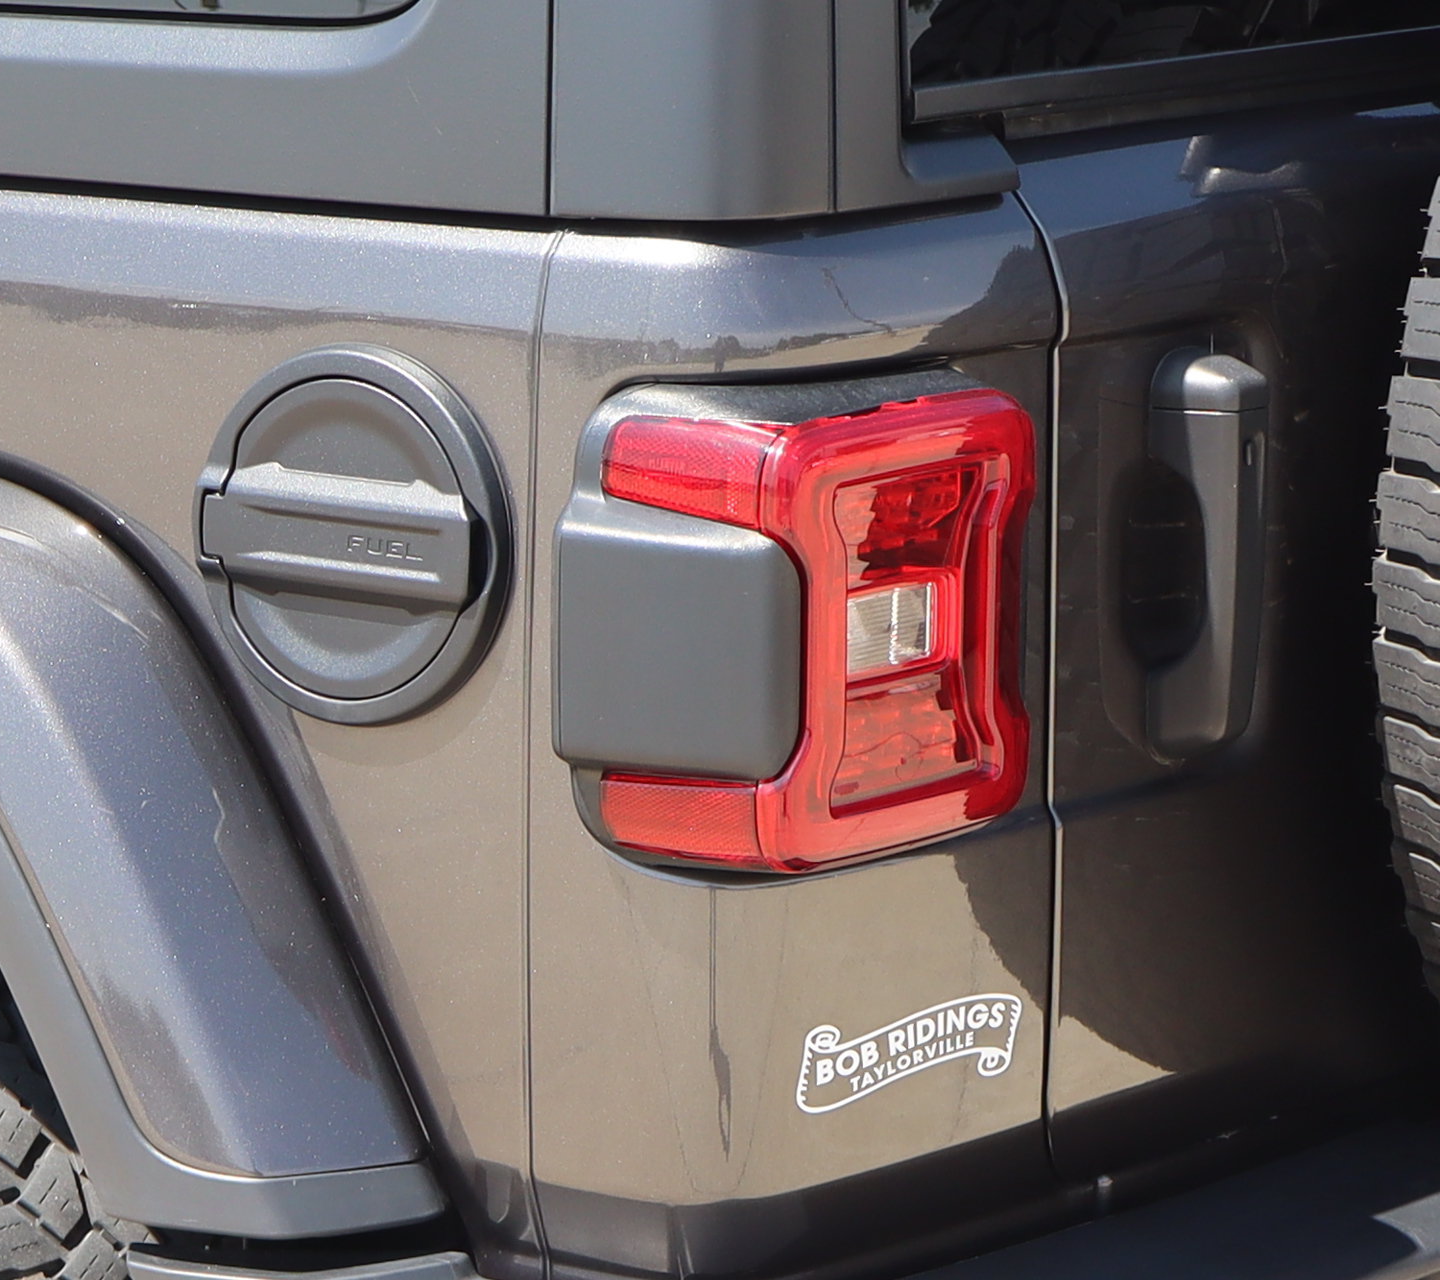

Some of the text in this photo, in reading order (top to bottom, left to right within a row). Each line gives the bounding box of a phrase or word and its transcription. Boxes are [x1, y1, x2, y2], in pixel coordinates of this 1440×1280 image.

[346, 535, 424, 562] FUEL
[816, 1001, 1006, 1086] BOB RIDINGS
[850, 1031, 974, 1092] TAYLORVILLE
